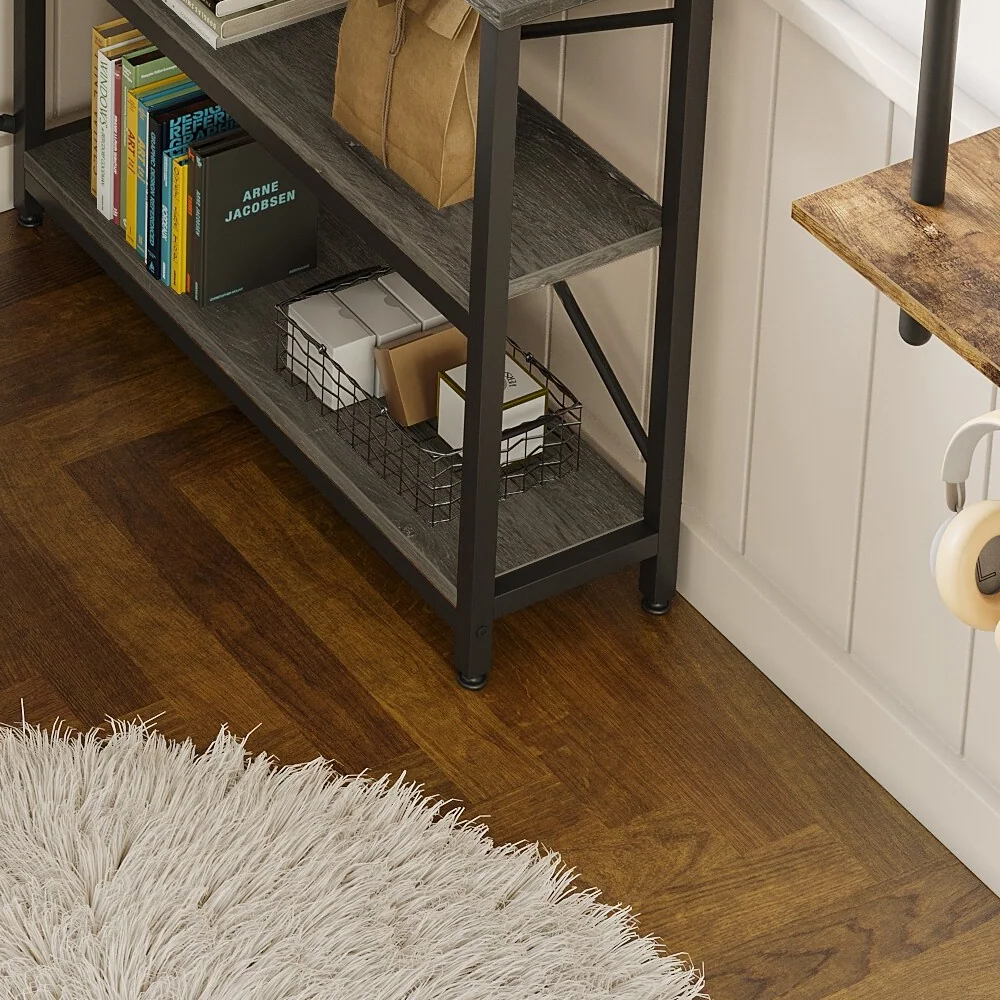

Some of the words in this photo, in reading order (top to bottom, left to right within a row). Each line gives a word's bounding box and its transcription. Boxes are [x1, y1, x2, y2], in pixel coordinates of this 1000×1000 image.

[100, 61, 108, 128] WINDOWS
[127, 128, 136, 156] ART
[137, 136, 146, 165] ART
[225, 190, 296, 222] JACOBSEN
[243, 181, 279, 202] ARNE
[161, 205, 169, 242] BORDEAUX
